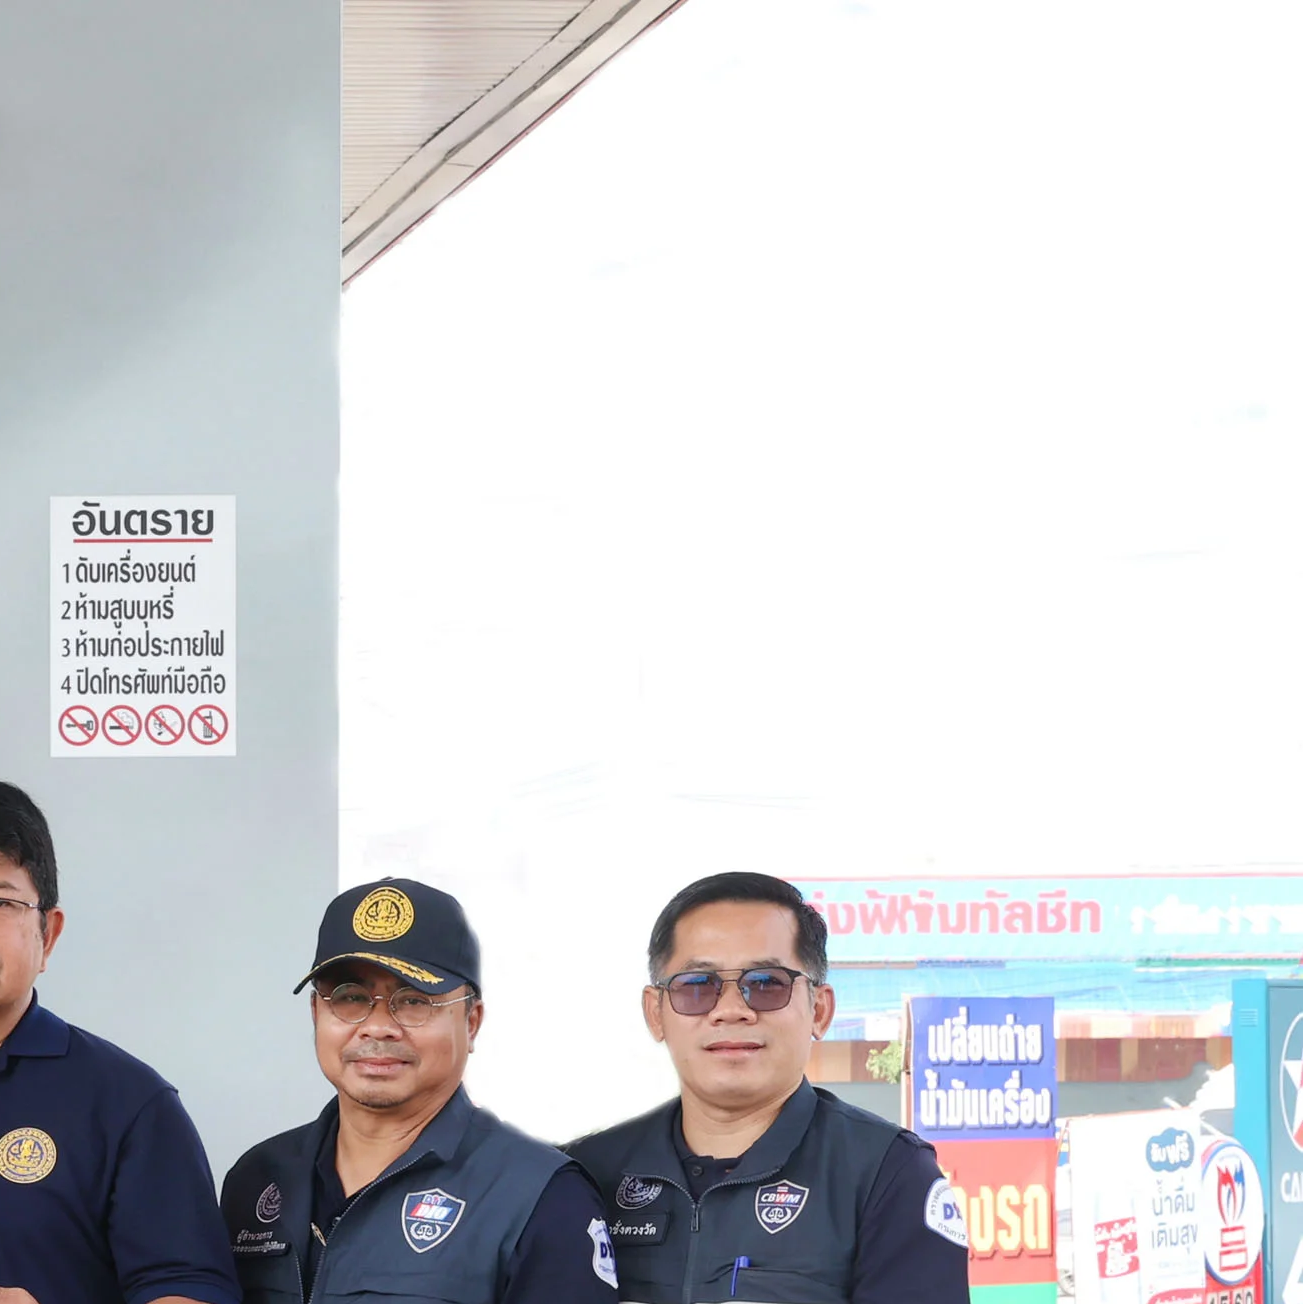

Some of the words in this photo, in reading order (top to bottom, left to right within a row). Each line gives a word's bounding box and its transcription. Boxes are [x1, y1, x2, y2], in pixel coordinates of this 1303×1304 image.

[72, 501, 214, 535] อันตราย
[62, 563, 70, 583] 1
[76, 549, 196, 583] ดับเครื่องยนต์
[61, 601, 71, 620] 2
[75, 586, 174, 628] ห้ามสูบบุหรี่
[61, 638, 71, 657] 3
[75, 630, 224, 657] ห้ามก่อประกายไฟ
[61, 676, 72, 694] 4
[77, 666, 226, 694] ปิดโทรศัพท์มือถือ
[927, 1006, 1044, 1064] เปลี่ยนถ่าย
[920, 1069, 1052, 1129] น้ำมันเครื่อง
[761, 1193, 801, 1203] CBWM
